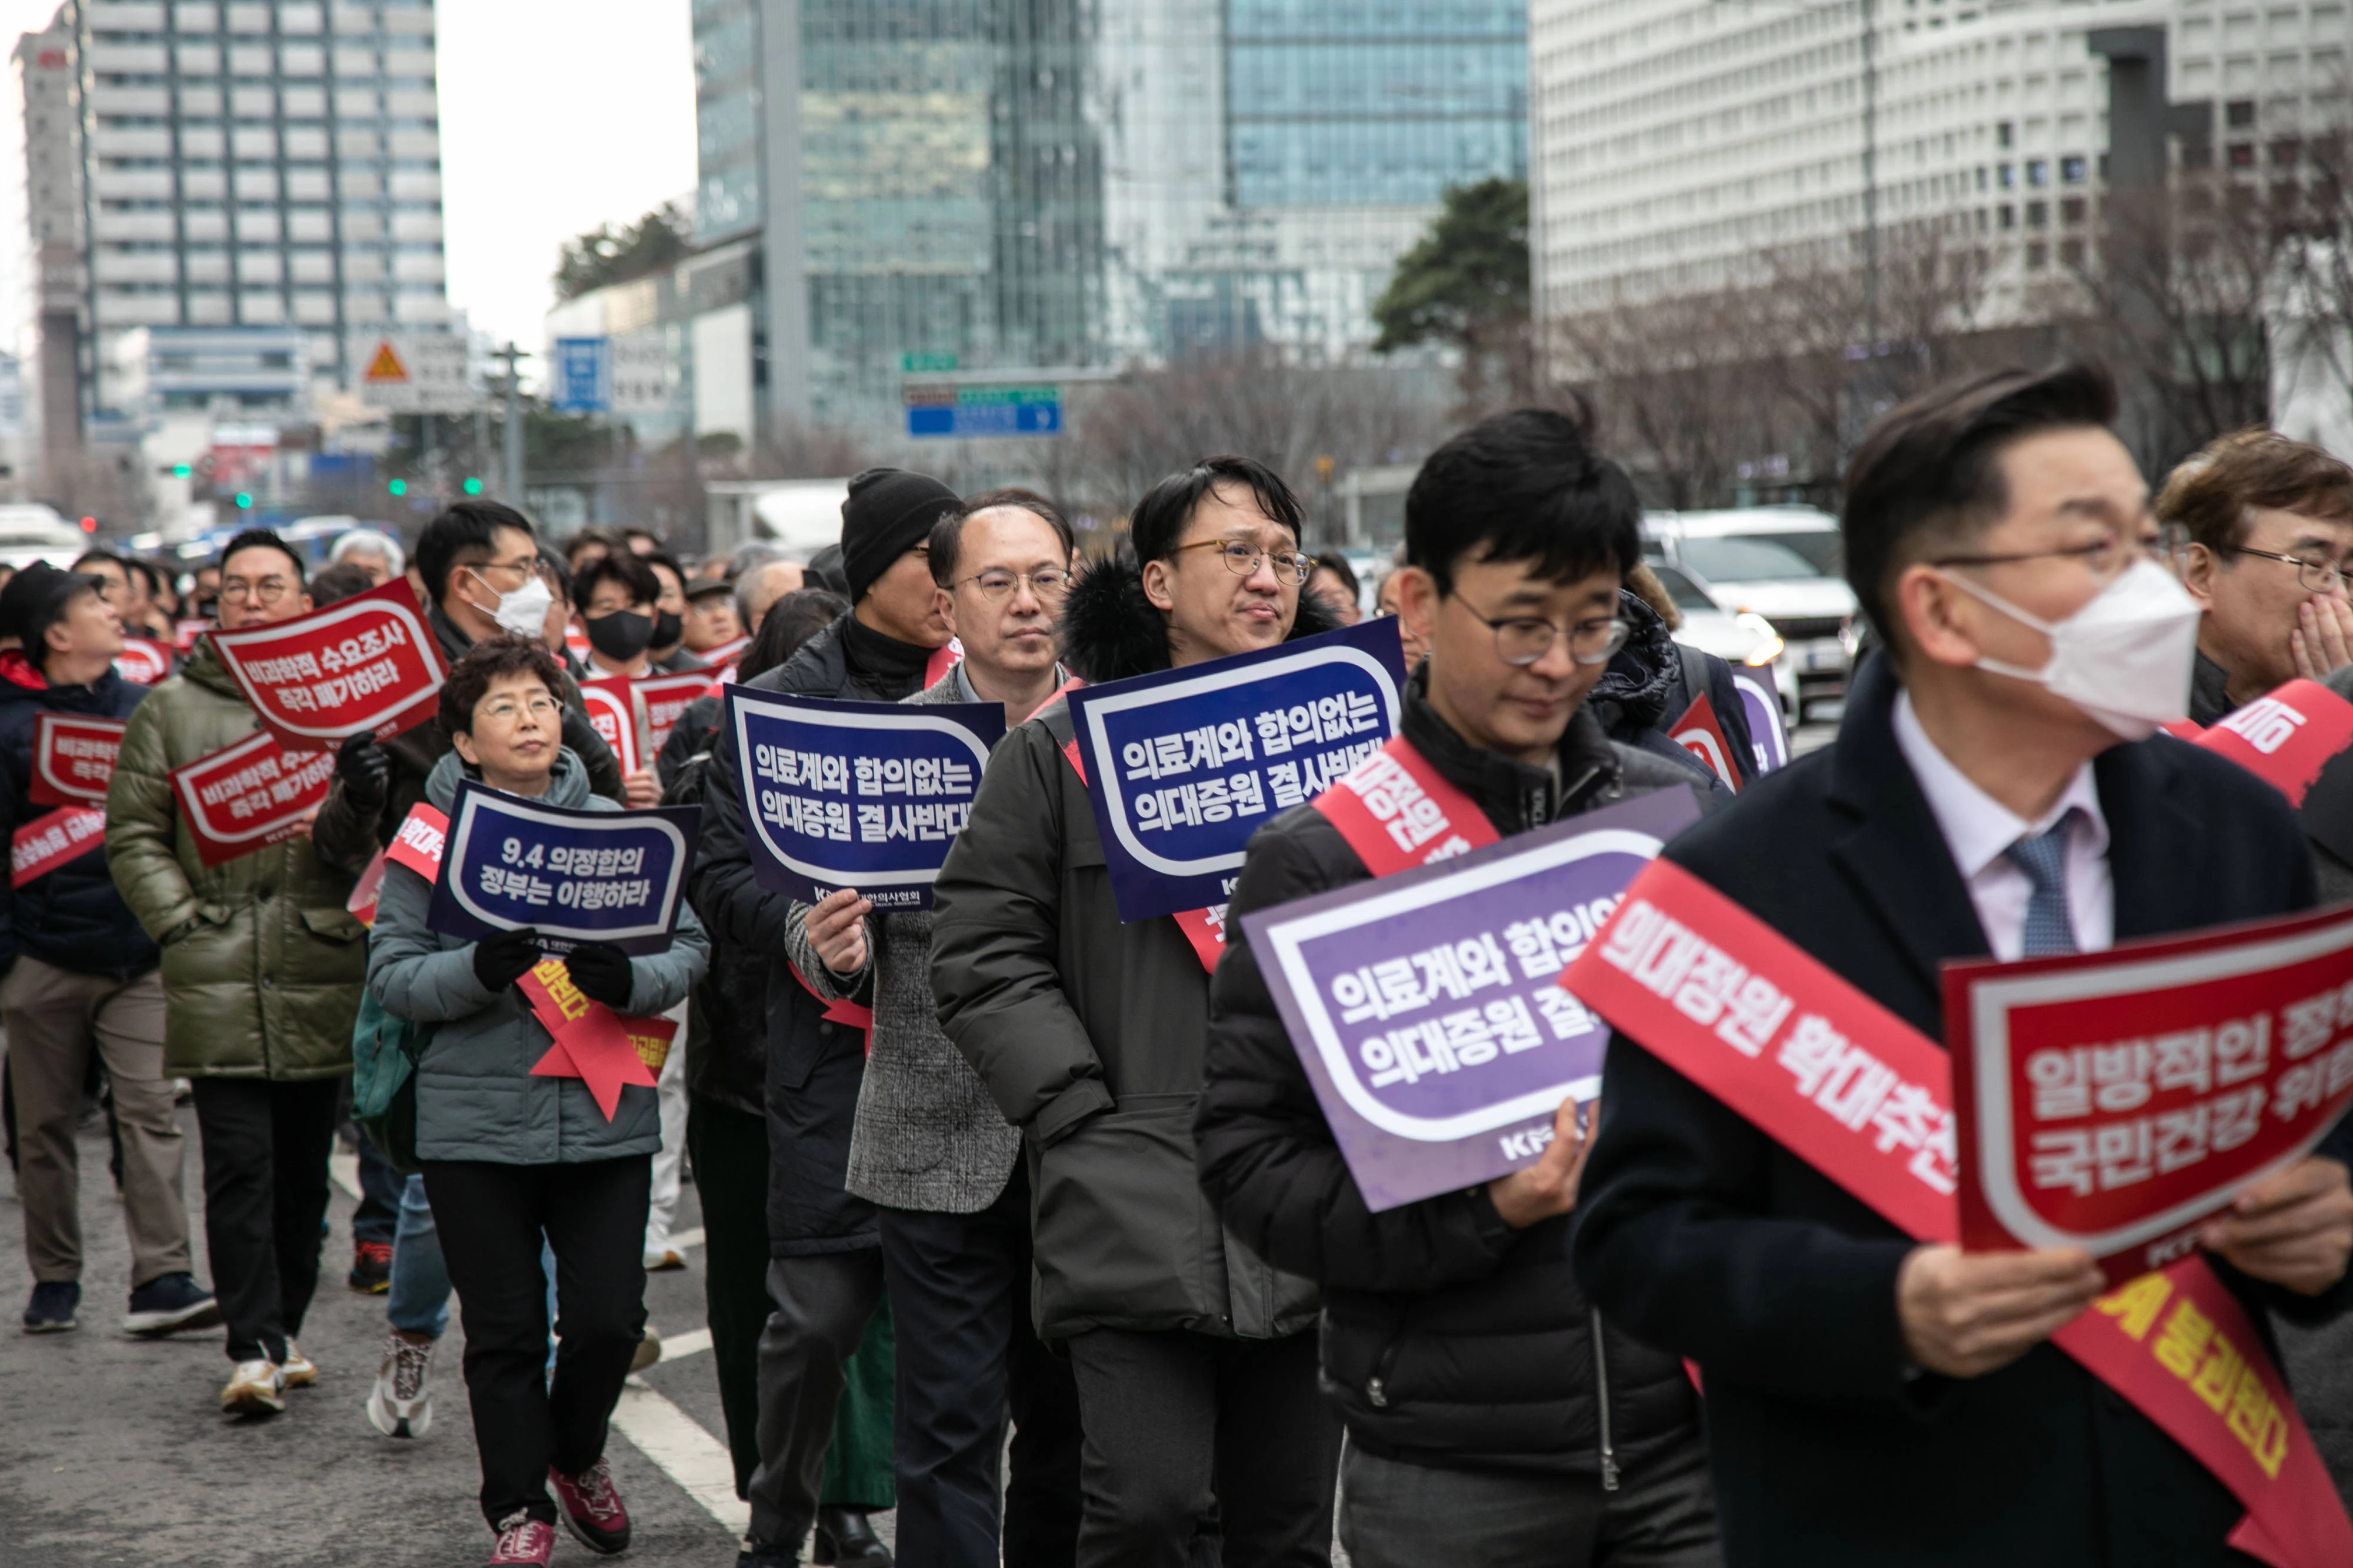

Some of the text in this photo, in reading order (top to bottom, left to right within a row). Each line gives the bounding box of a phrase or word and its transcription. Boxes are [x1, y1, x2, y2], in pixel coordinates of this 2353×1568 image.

[242, 619, 406, 685] 비과학적 수요조사
[275, 658, 401, 712] 즉각 폐기하라
[1122, 690, 1379, 780] 의료계와 합의없는
[755, 743, 972, 797] 의료계와 합의없는
[1135, 770, 1267, 832] 의대증원
[762, 789, 971, 843] 의대증원 결사반대
[480, 864, 651, 910] 정부는 이행하라
[501, 837, 645, 877] 9.4 의정합의
[532, 959, 591, 1022] 괴된다
[1331, 933, 1512, 1024] 의료계와
[1598, 900, 1795, 1059] 의대정원
[1359, 995, 1544, 1089] 의대증원
[2029, 1011, 2271, 1120] 일방적인
[2029, 1083, 2267, 1196] 국민건강
